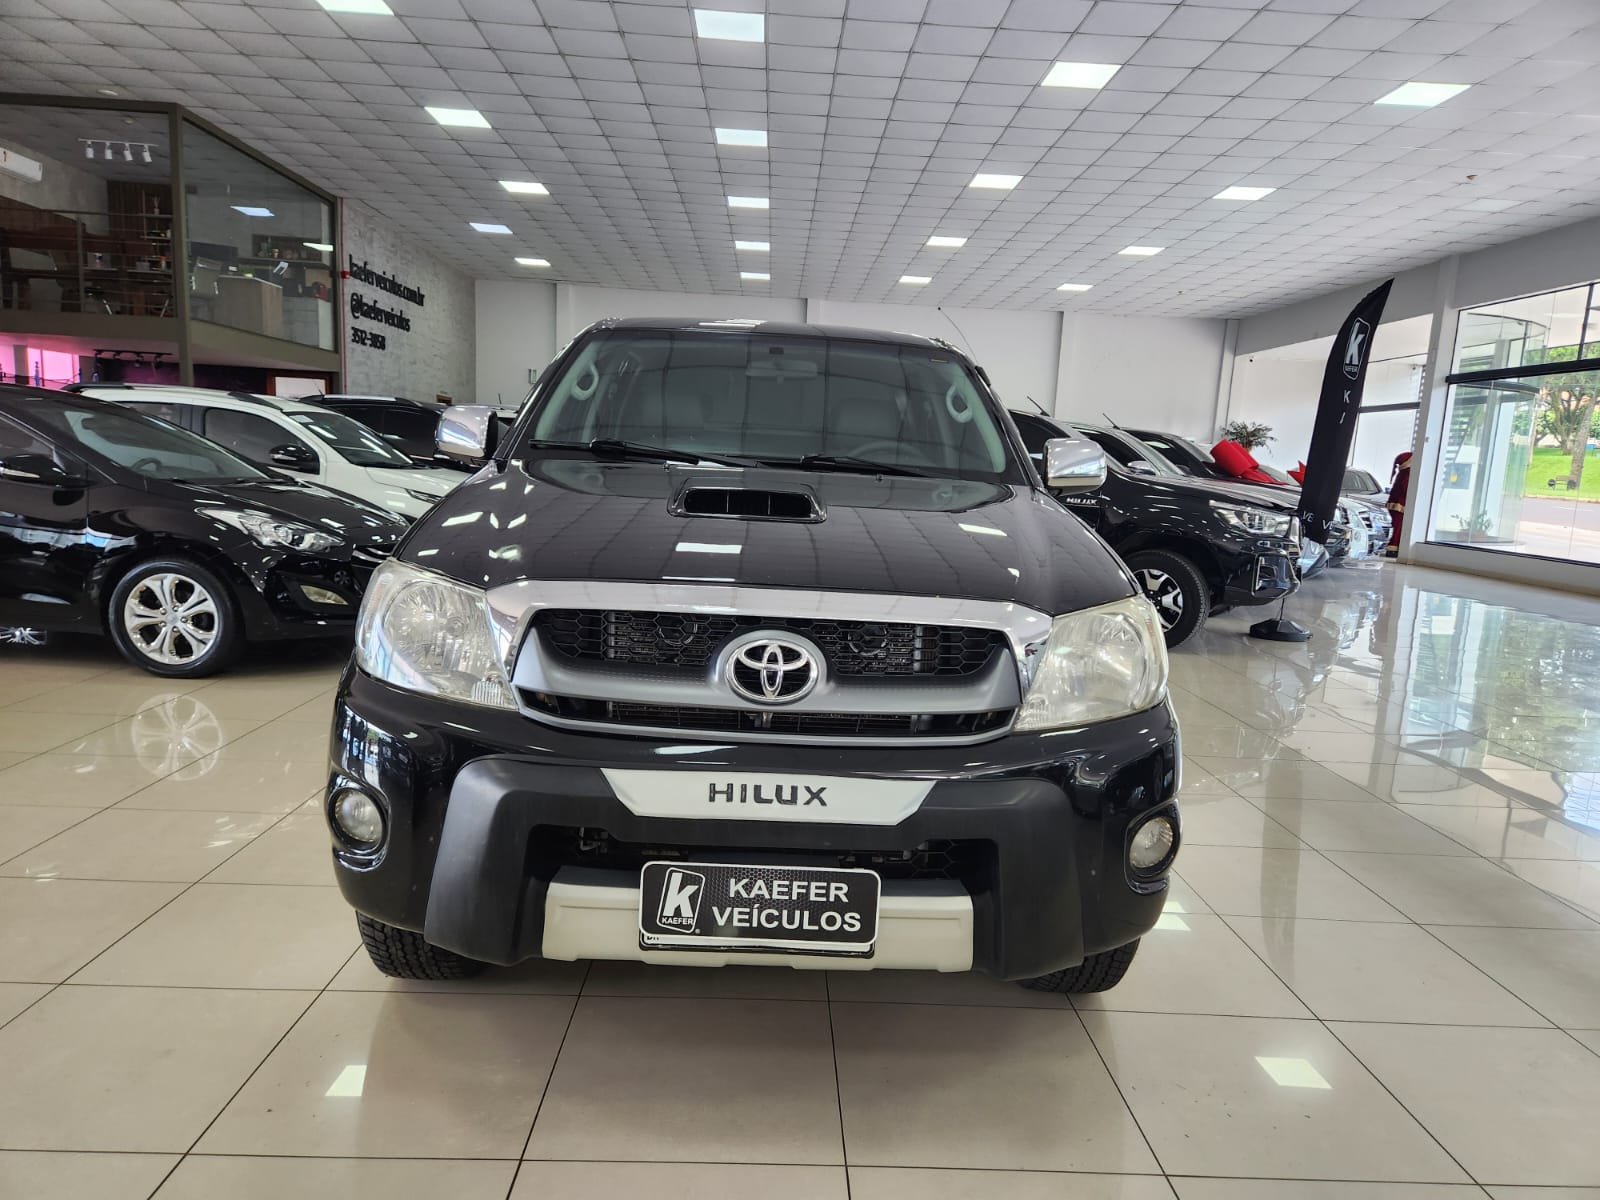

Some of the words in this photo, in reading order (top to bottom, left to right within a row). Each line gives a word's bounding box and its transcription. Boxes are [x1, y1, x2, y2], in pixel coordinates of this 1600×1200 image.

[709, 783, 828, 807] HILUX
[729, 878, 849, 902] KAEFER
[661, 917, 694, 925] KAEFER
[712, 903, 862, 932] VEÍCULOS
